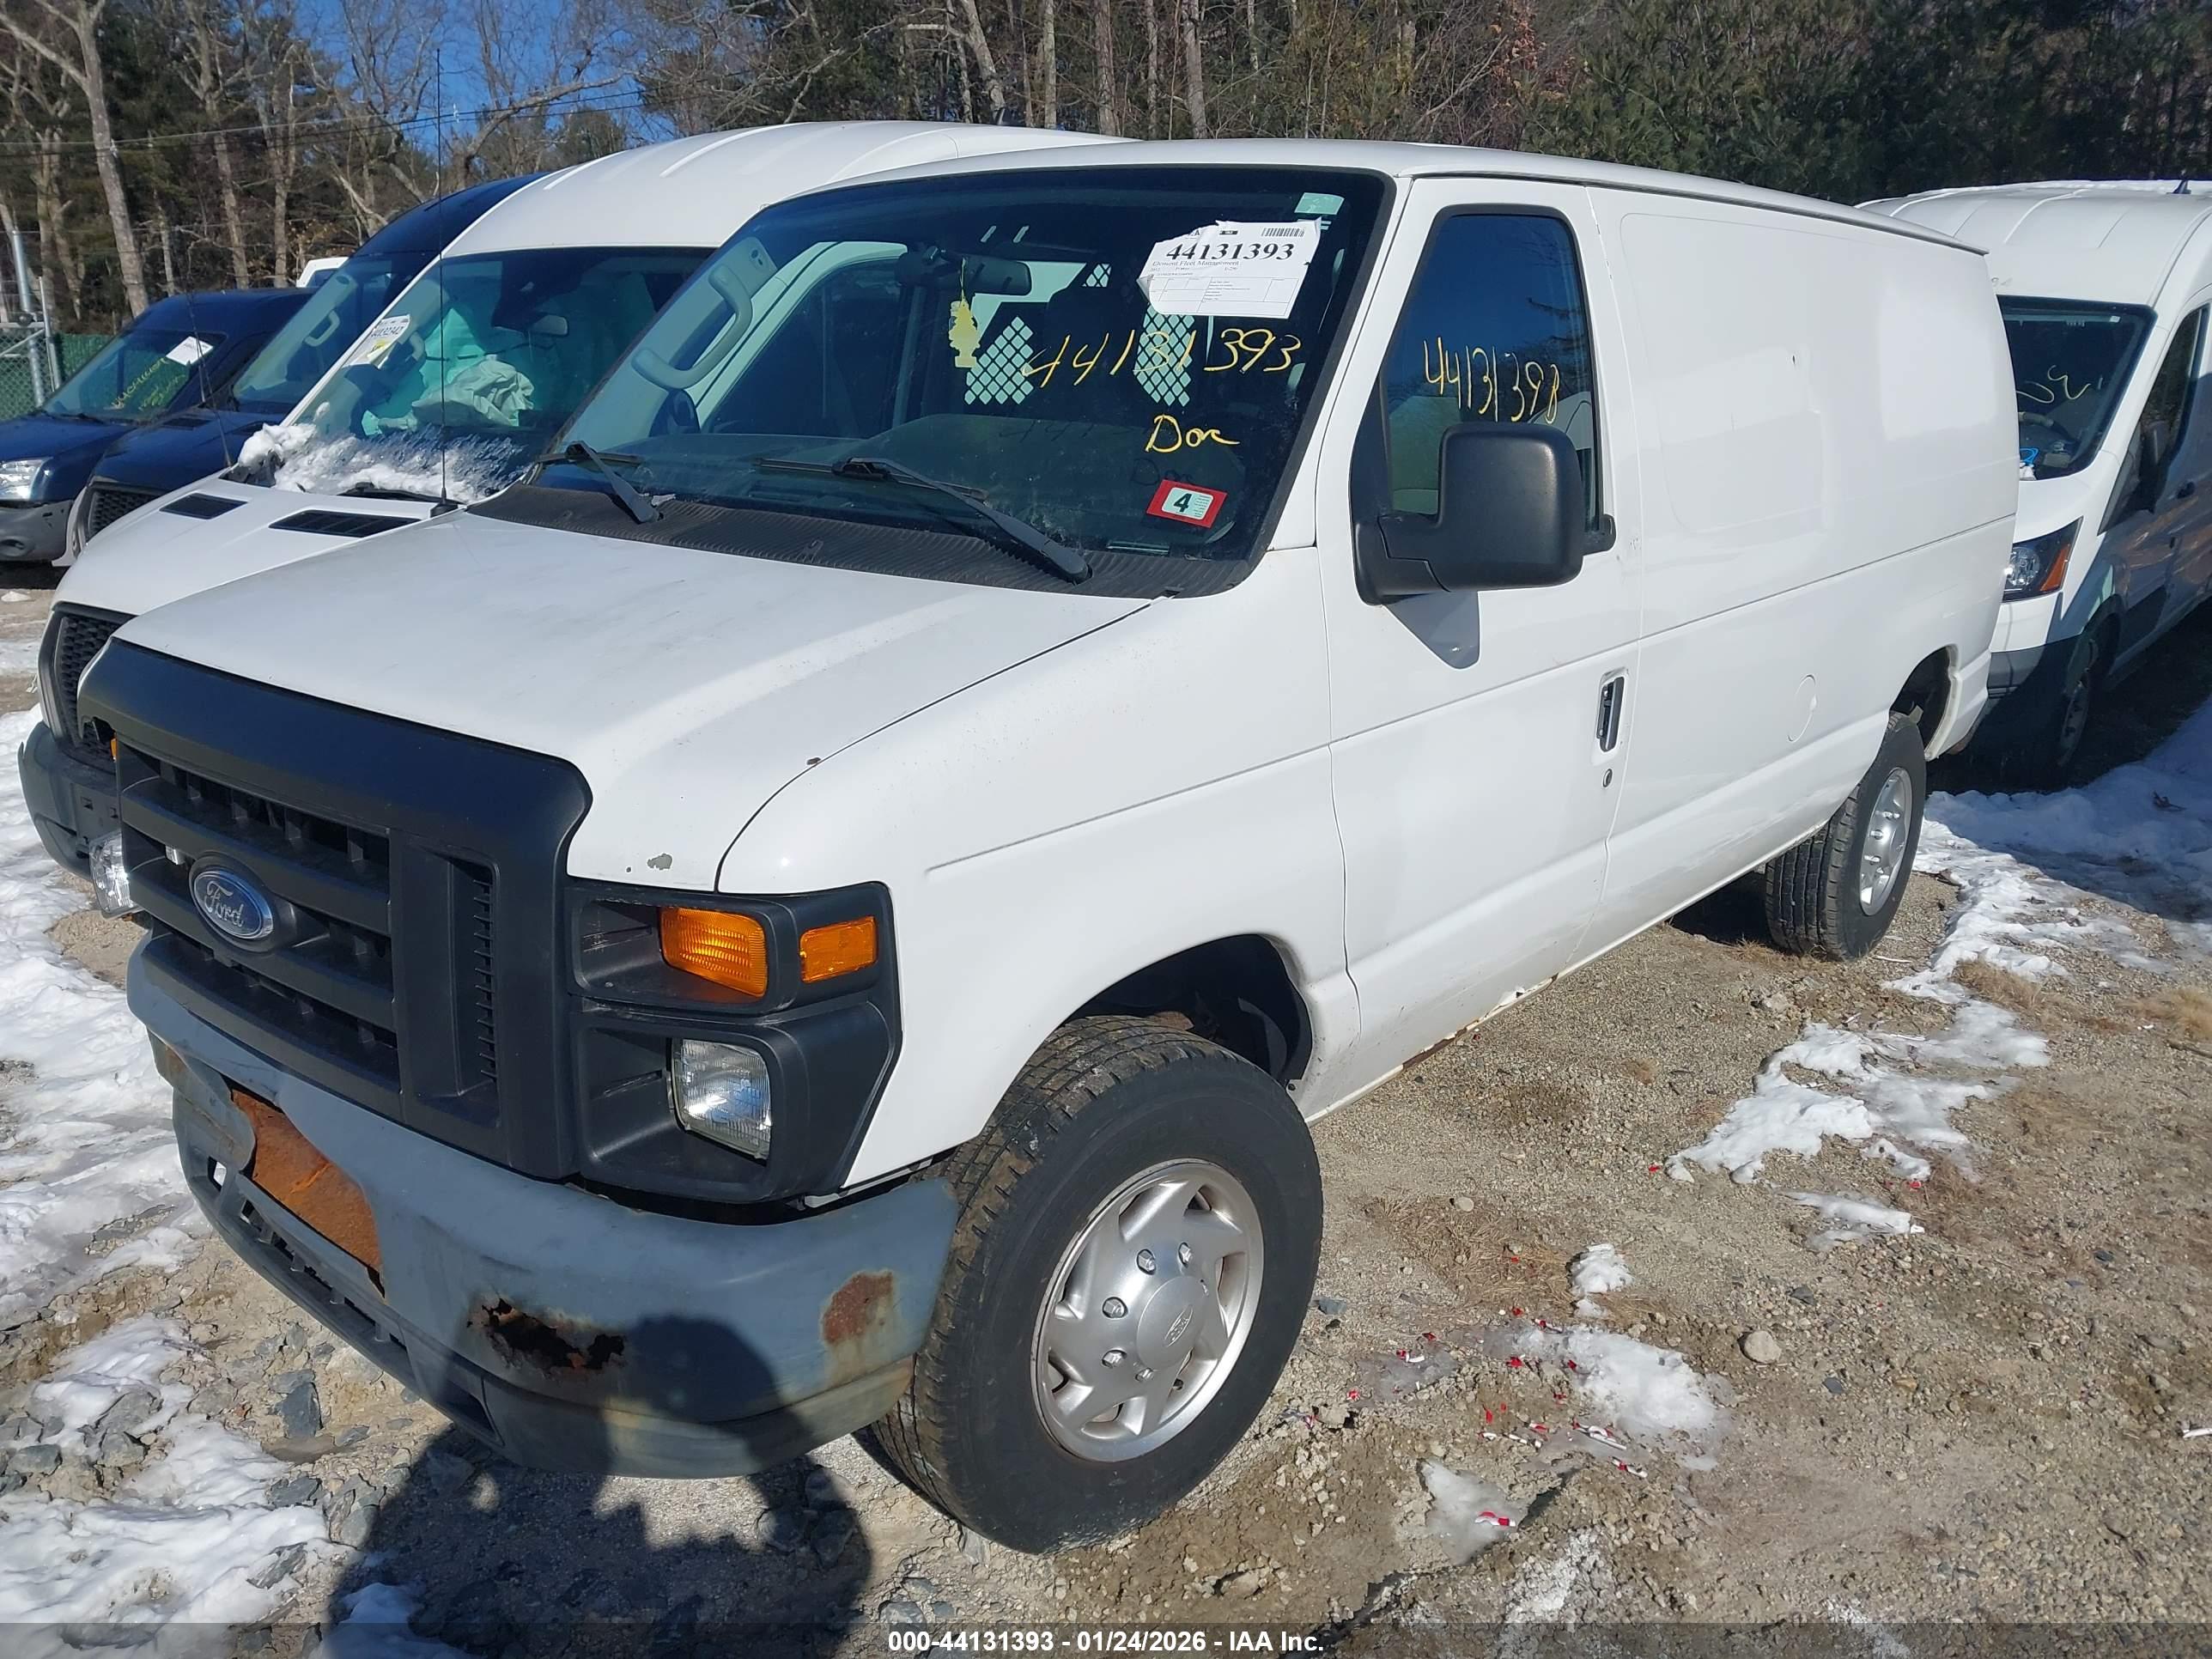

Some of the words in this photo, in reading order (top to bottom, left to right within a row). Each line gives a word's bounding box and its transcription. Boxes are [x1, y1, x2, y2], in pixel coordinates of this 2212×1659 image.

[1166, 243, 1295, 260] 44131393
[1021, 328, 1302, 388] 44131393
[1173, 493, 1193, 513] 4
[204, 880, 245, 927] Ford
